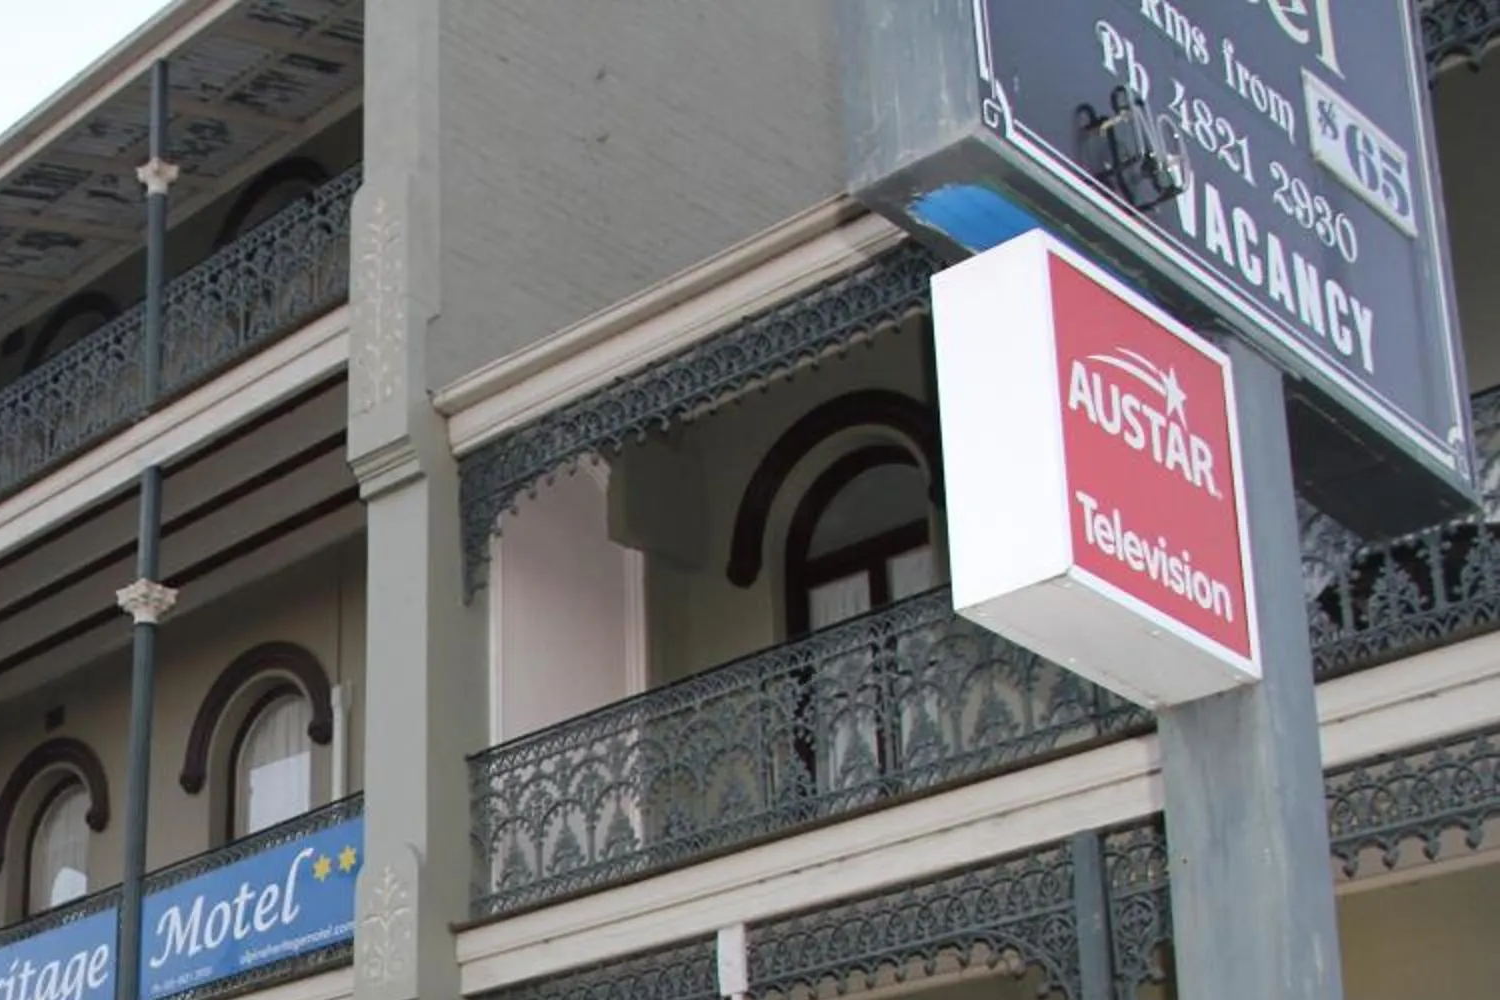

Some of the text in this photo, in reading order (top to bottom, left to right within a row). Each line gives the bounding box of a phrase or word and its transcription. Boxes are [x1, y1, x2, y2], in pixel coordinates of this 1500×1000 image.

[1095, 19, 1358, 264] Ph 4821 2930
[1222, 37, 1296, 144] from
[1172, 164, 1373, 374] VACANCY
[1068, 359, 1218, 497] AUSTAR
[1075, 490, 1234, 623] Television
[150, 846, 315, 968] Motel
